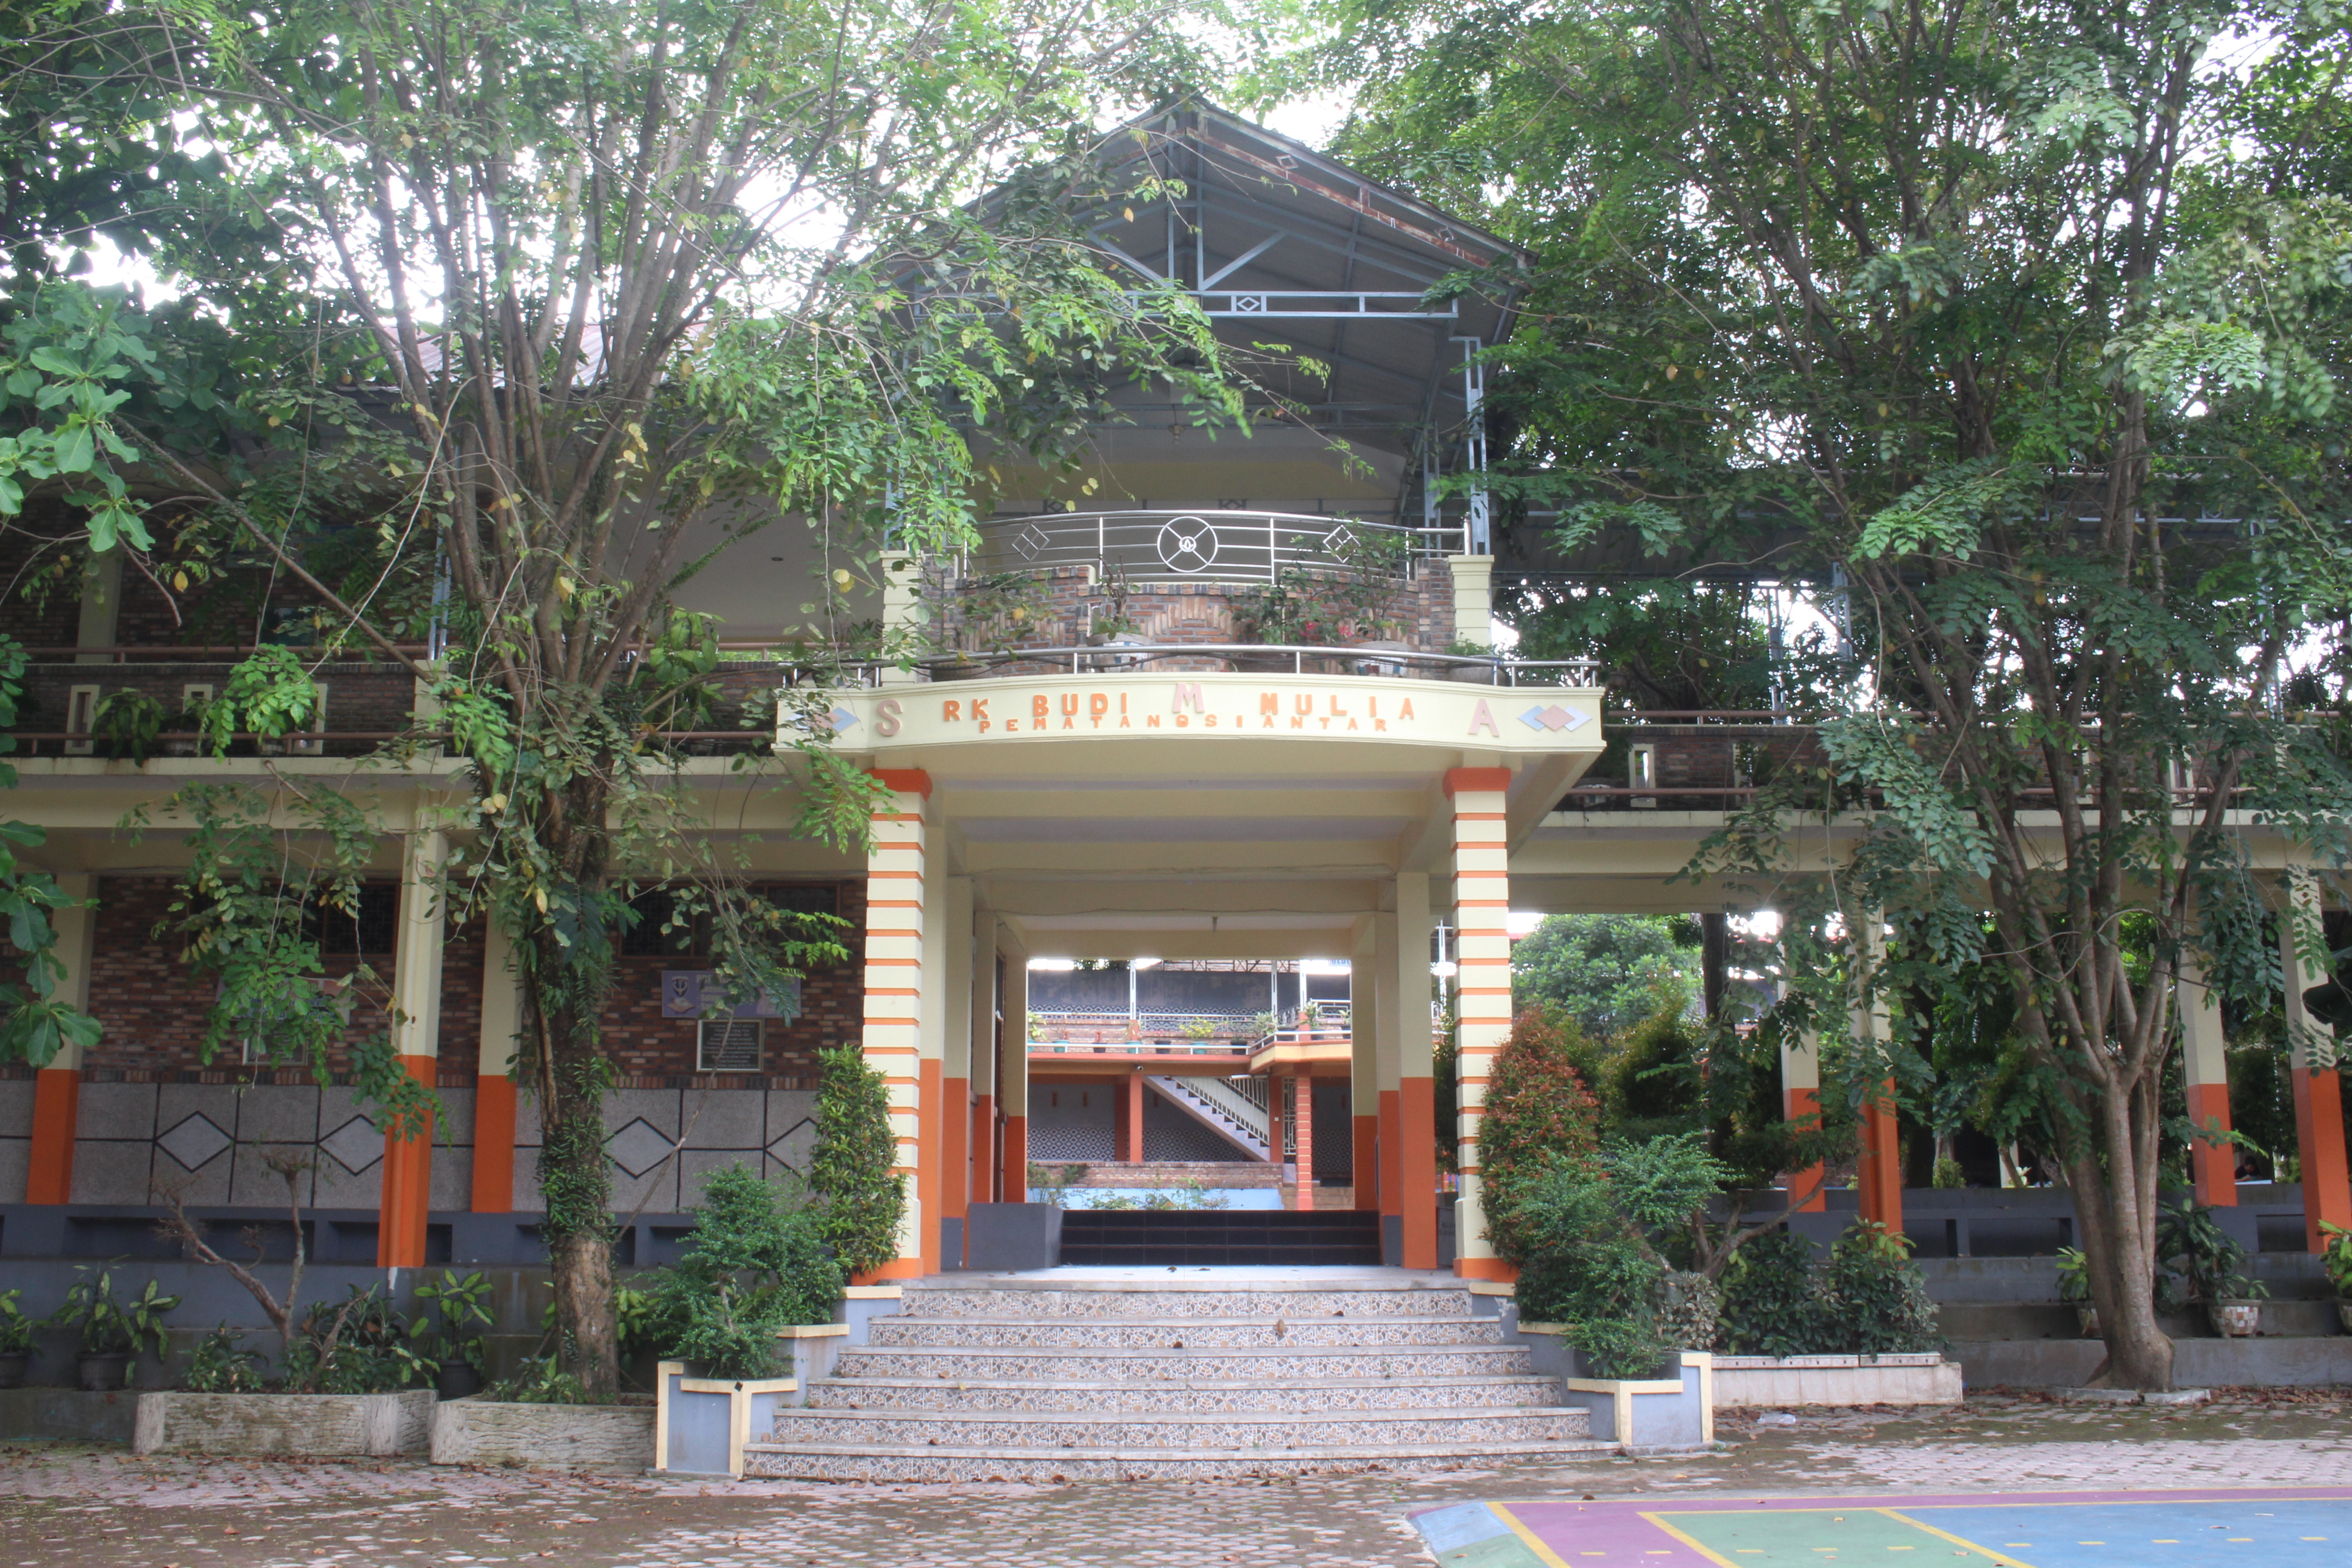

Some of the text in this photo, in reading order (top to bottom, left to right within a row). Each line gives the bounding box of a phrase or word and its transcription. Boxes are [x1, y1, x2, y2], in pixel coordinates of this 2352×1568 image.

[876, 682, 1499, 736] S M A
[944, 692, 1414, 721] RK BUDI MULIA
